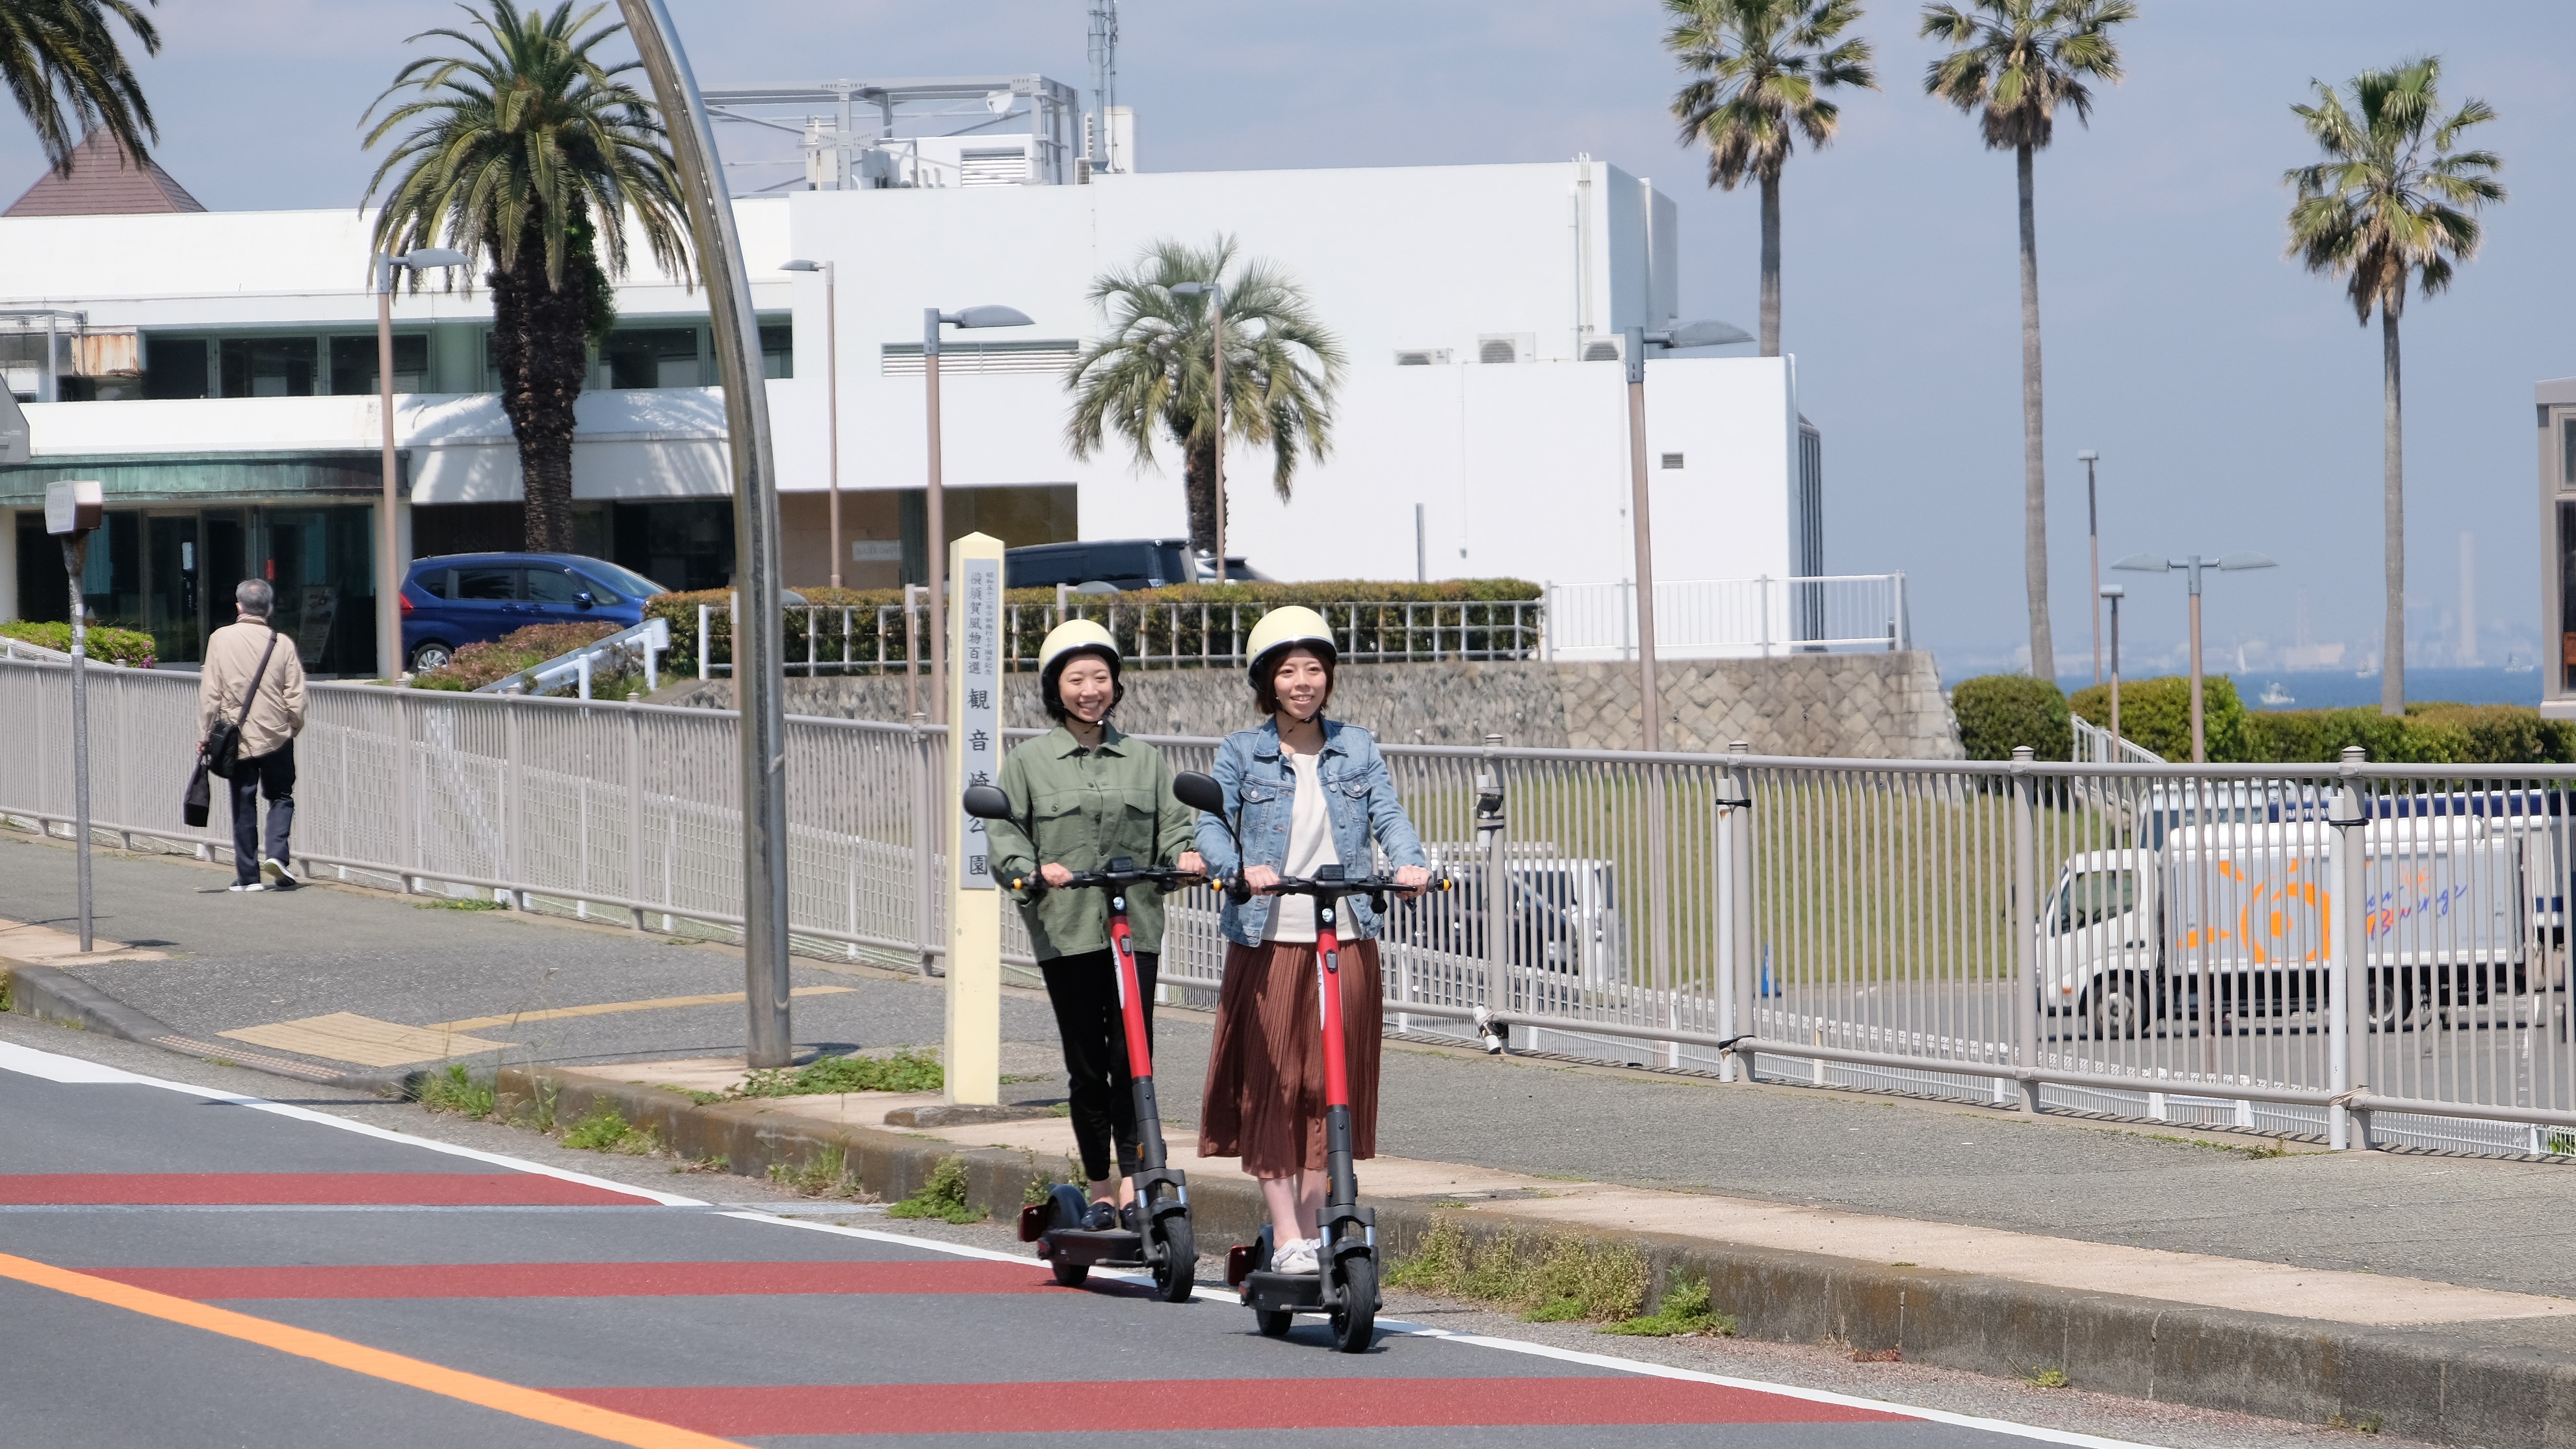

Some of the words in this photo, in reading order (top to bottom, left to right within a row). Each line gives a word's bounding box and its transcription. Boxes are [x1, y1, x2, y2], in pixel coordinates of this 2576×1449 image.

[968, 571, 982, 675] 横須賀風物百選
